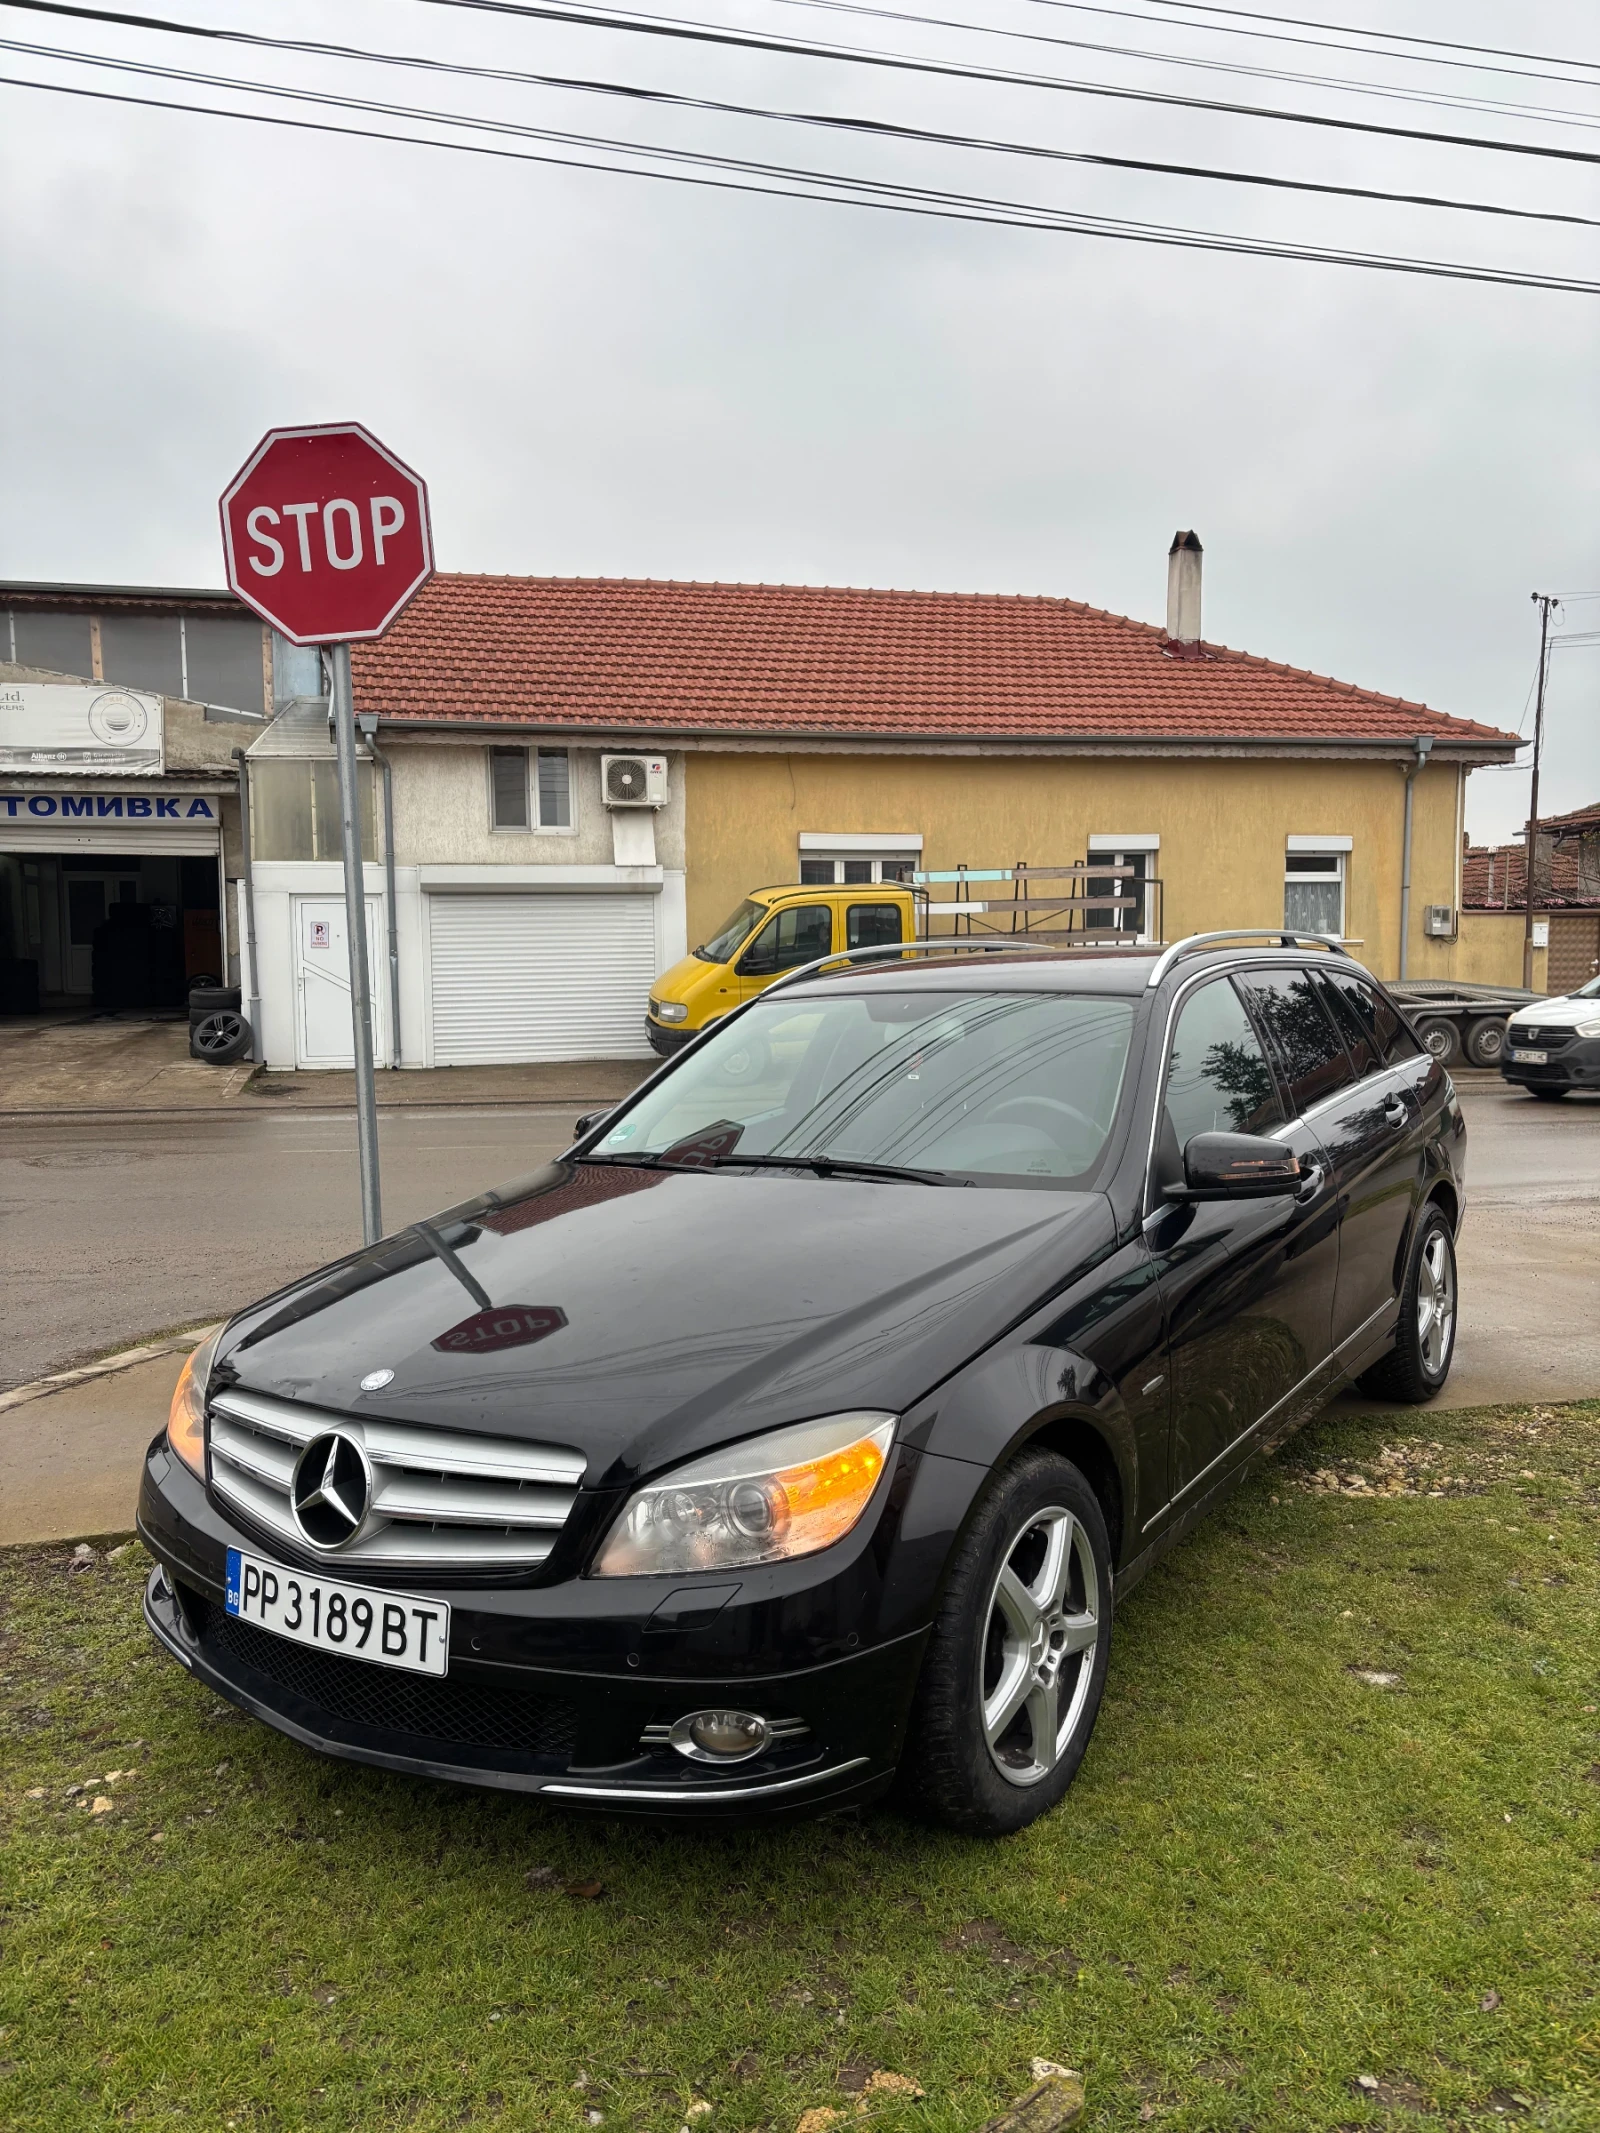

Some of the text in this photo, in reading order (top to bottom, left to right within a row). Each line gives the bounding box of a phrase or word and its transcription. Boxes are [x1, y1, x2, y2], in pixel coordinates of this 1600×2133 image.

[247, 496, 405, 576] STOP
[31, 752, 56, 760] Allianz
[0, 796, 214, 818] ТОМИВКА
[228, 1589, 239, 1606] BG
